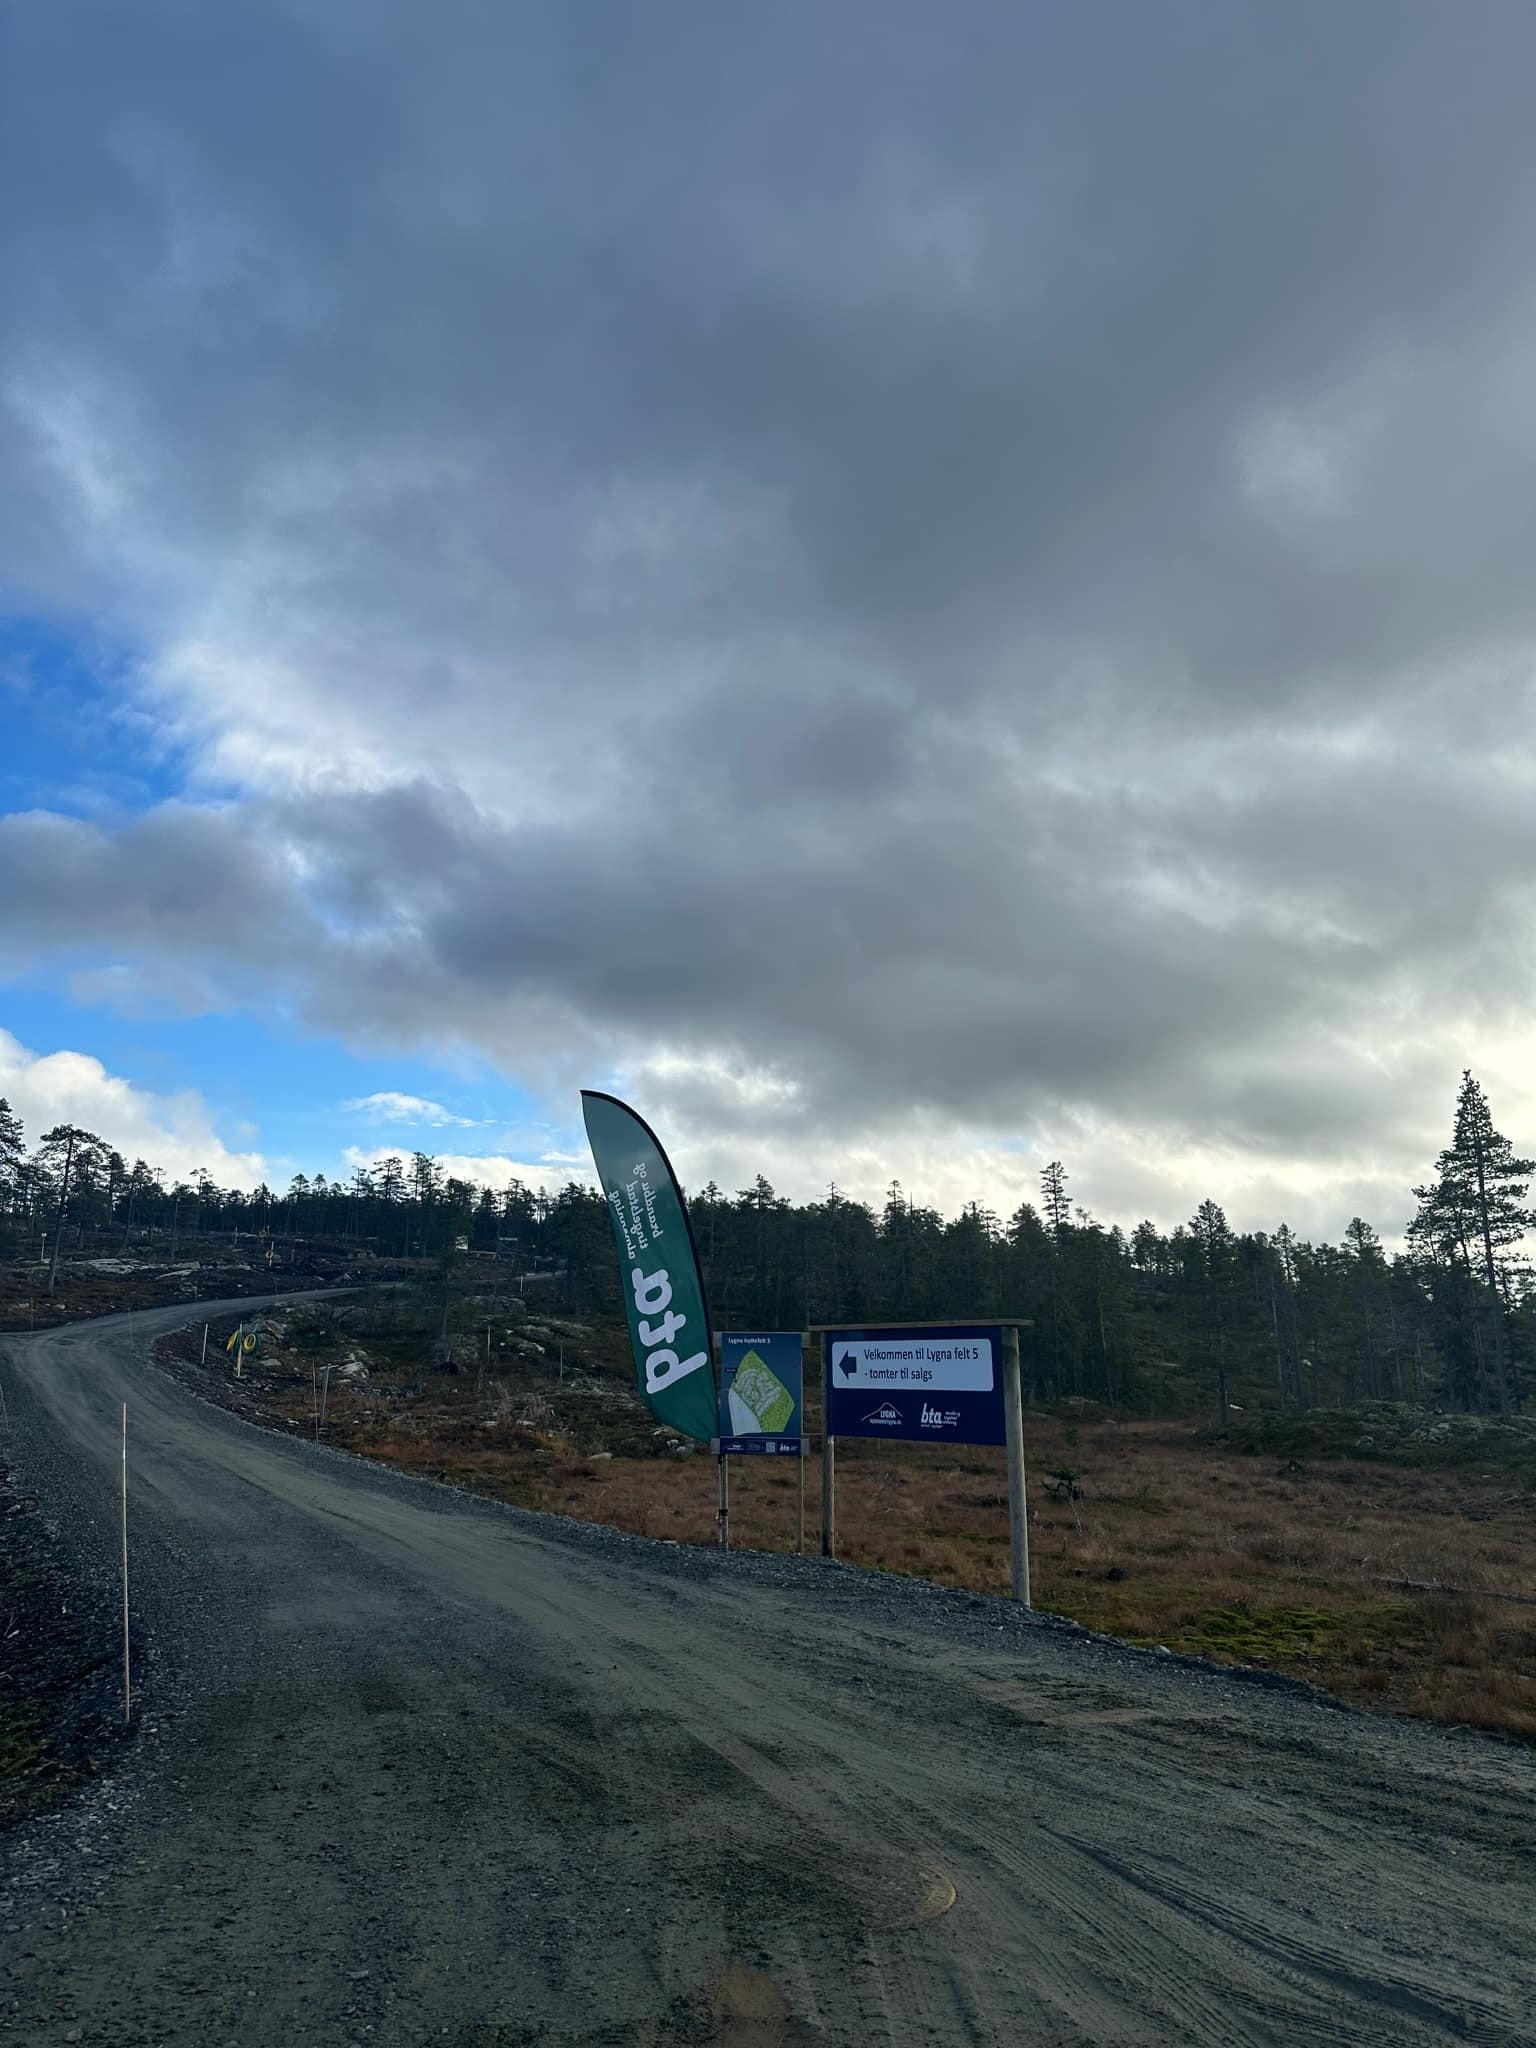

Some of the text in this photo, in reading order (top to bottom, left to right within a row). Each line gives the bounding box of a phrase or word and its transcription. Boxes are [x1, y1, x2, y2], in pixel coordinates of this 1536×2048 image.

[864, 1347, 978, 1363] Velkommen til Lygna felt 5
[869, 1369, 898, 1379] tomter
[900, 1368, 909, 1379] til
[911, 1368, 933, 1382] salgs
[880, 1410, 896, 1418] LYGNA
[921, 1402, 942, 1424] bta
